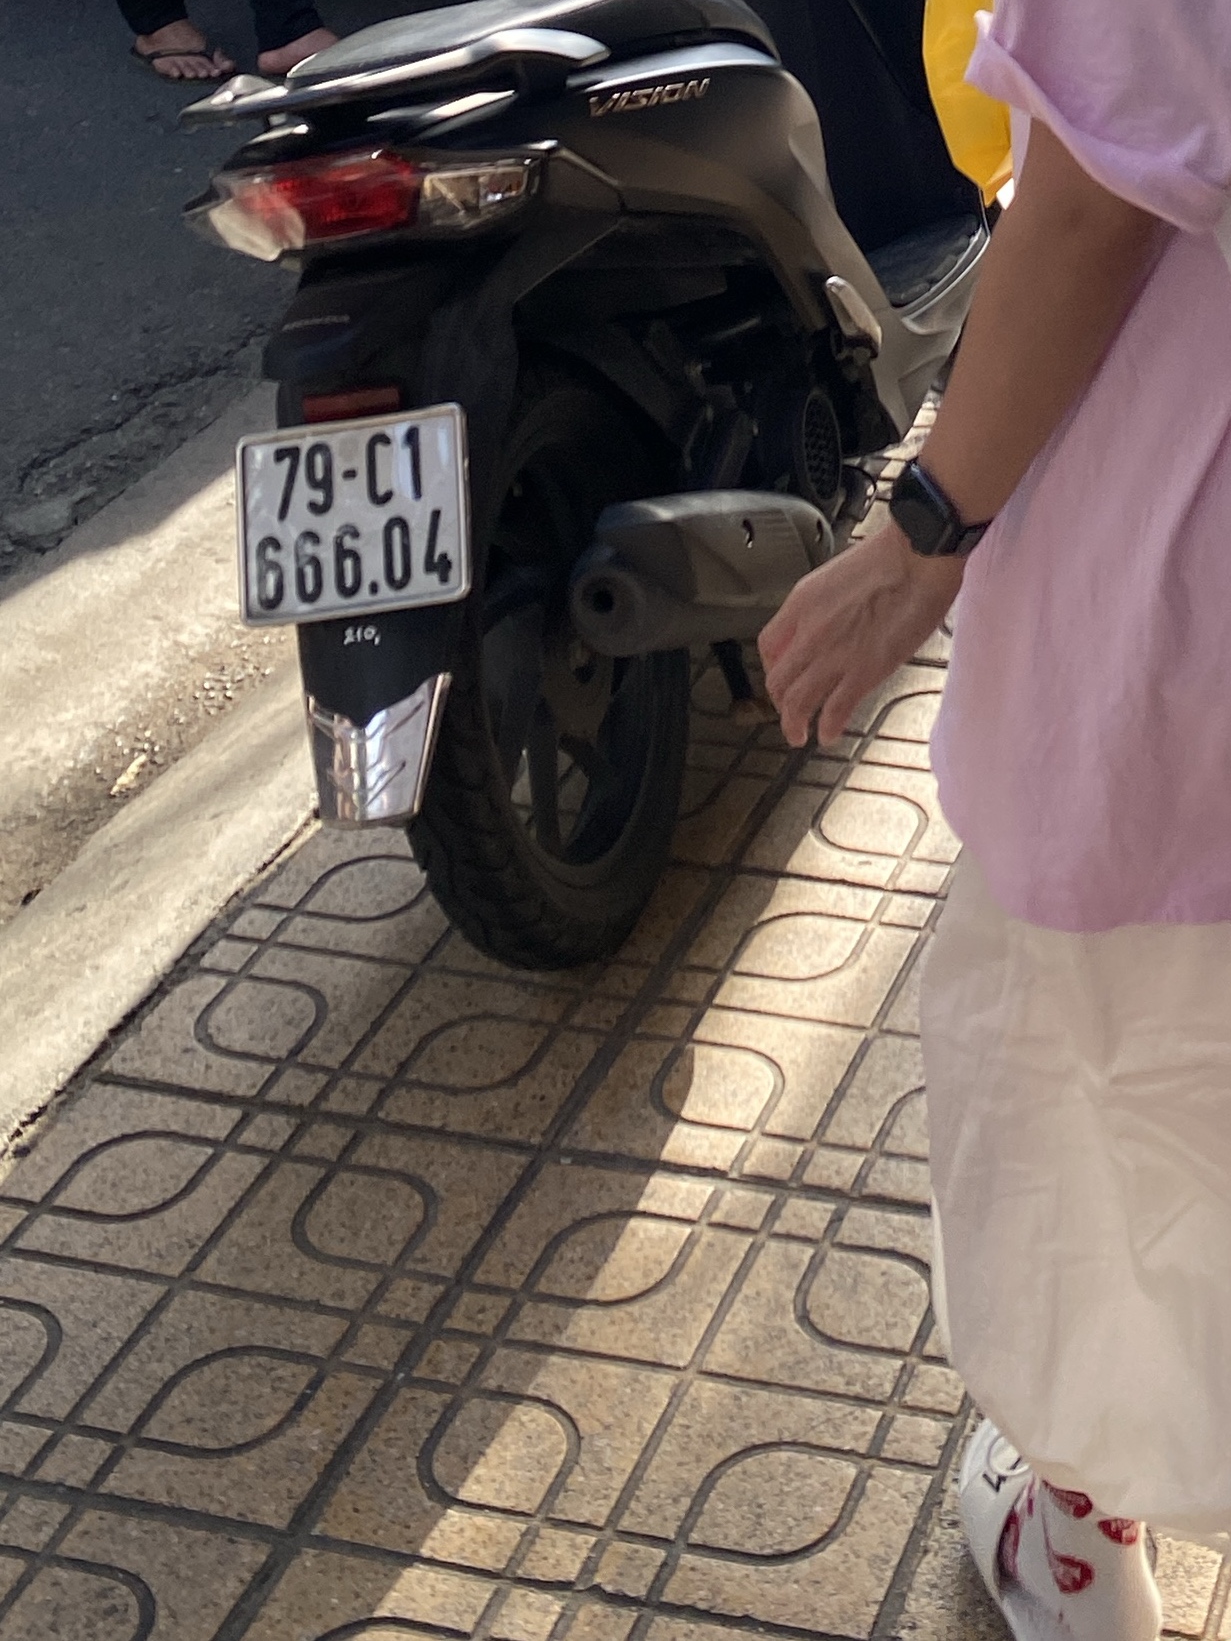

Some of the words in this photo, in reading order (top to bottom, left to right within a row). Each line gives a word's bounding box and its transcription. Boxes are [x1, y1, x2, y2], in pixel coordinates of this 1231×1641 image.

[588, 77, 711, 118] VISION
[273, 424, 423, 523] 79-C1
[255, 508, 453, 610] 666.04
